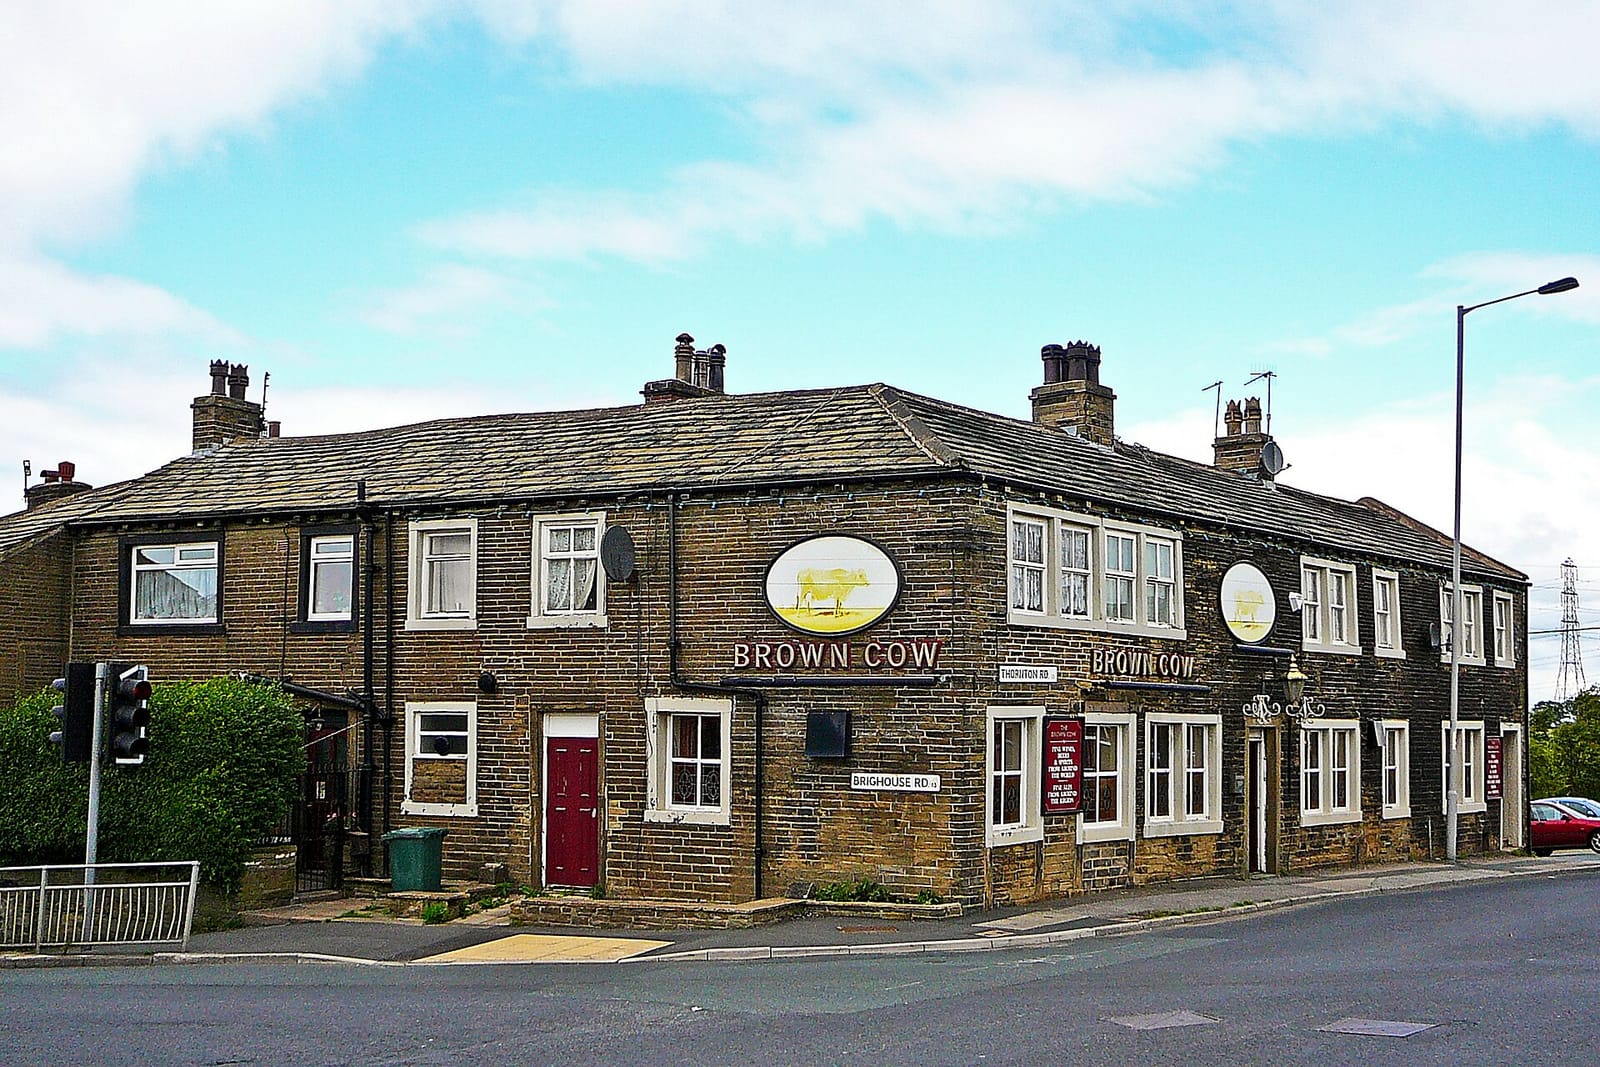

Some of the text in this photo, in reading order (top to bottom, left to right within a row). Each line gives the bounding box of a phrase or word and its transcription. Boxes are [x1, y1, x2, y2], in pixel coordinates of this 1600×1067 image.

[734, 642, 939, 668] BROWN COW
[1093, 649, 1195, 678] BROWN COW
[1001, 669, 1038, 679] THORNTON
[853, 776, 911, 788] BRIGHOUSE
